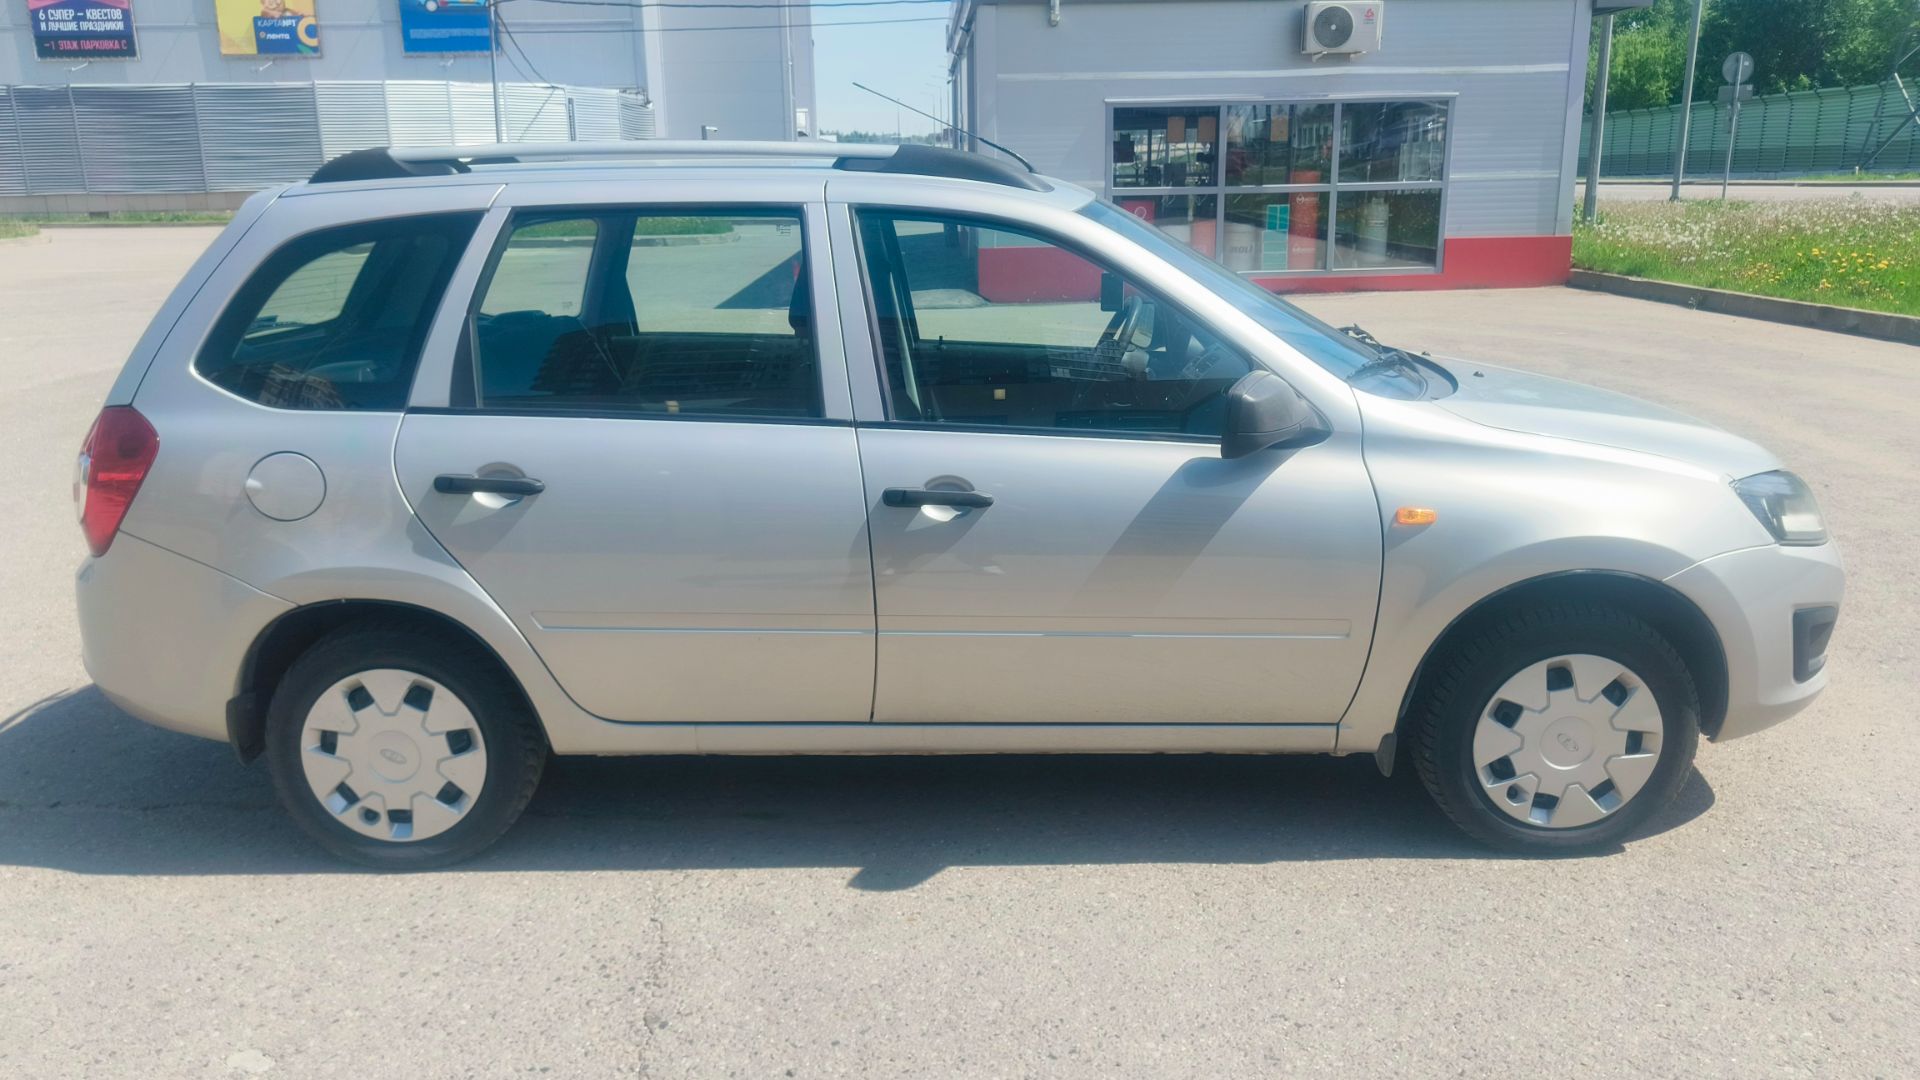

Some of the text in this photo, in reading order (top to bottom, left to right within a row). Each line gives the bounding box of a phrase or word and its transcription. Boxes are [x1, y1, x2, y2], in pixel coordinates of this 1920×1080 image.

[39, 9, 45, 20] 6
[47, 9, 75, 20] СУПЕР
[85, 8, 122, 20] КВЕСТОВ
[40, 21, 47, 31] И
[48, 21, 79, 31] ЛУЧШИЕ
[58, 40, 79, 50] ЭТАЖ
[80, 40, 120, 50] ПАРКОВКА
